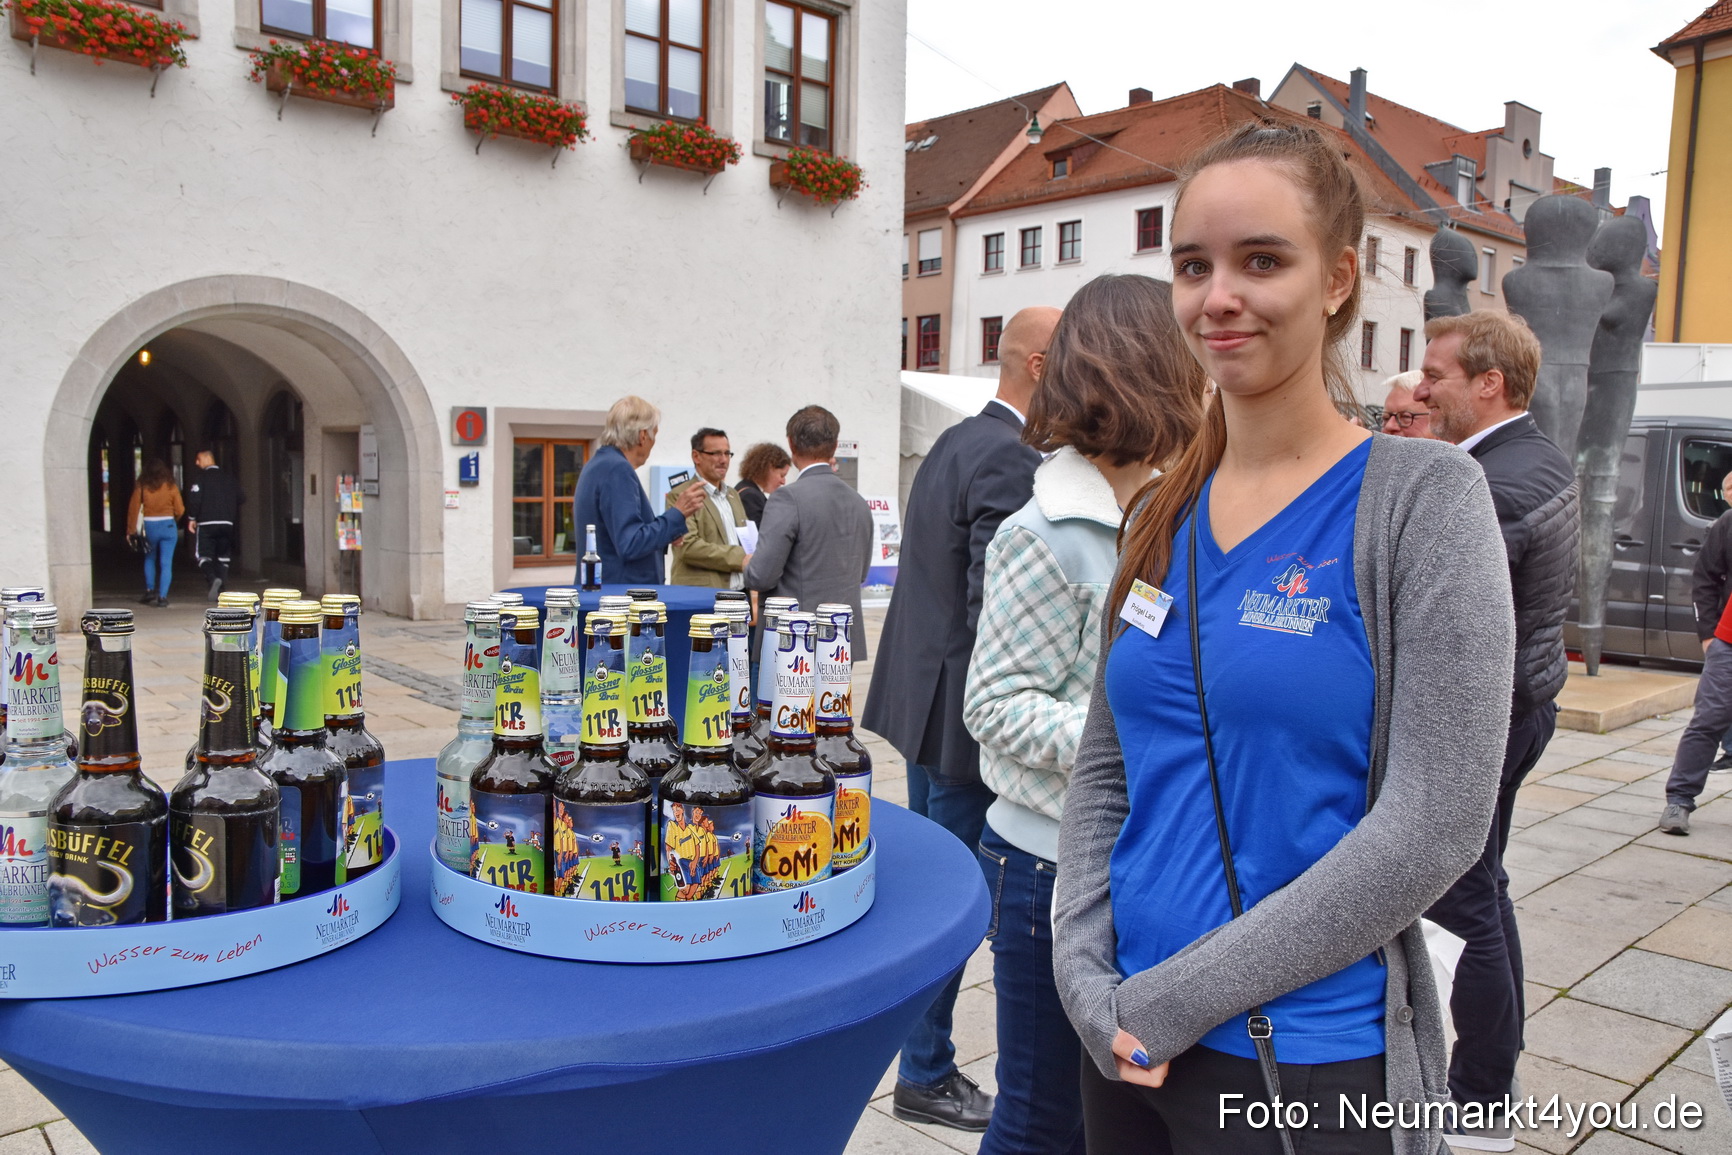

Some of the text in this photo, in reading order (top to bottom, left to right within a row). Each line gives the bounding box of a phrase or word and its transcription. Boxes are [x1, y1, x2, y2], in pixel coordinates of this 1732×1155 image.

[1237, 589, 1331, 623] NEUMARKTER
[1240, 611, 1316, 633] MINERALBRUNNEN
[631, 662, 664, 682] Glossner
[645, 675, 663, 683] Bräu
[503, 684, 524, 694] Bräu
[585, 677, 621, 699] Glossner
[599, 691, 619, 700] Bräu
[646, 708, 666, 717] PILS
[502, 720, 526, 730] PILS
[600, 728, 622, 738] PILS
[765, 819, 817, 835] NEUMARKTER
[65, 852, 89, 864] DRINK
[0, 864, 47, 884] ARKTE
[316, 910, 359, 940] NEUMARKTER
[485, 912, 531, 937] NEUMARKTER
[782, 908, 825, 933] NEUMARKTER
[584, 920, 732, 945] Wasser zum Leben
[88, 933, 263, 974] Wasser zum Leben
